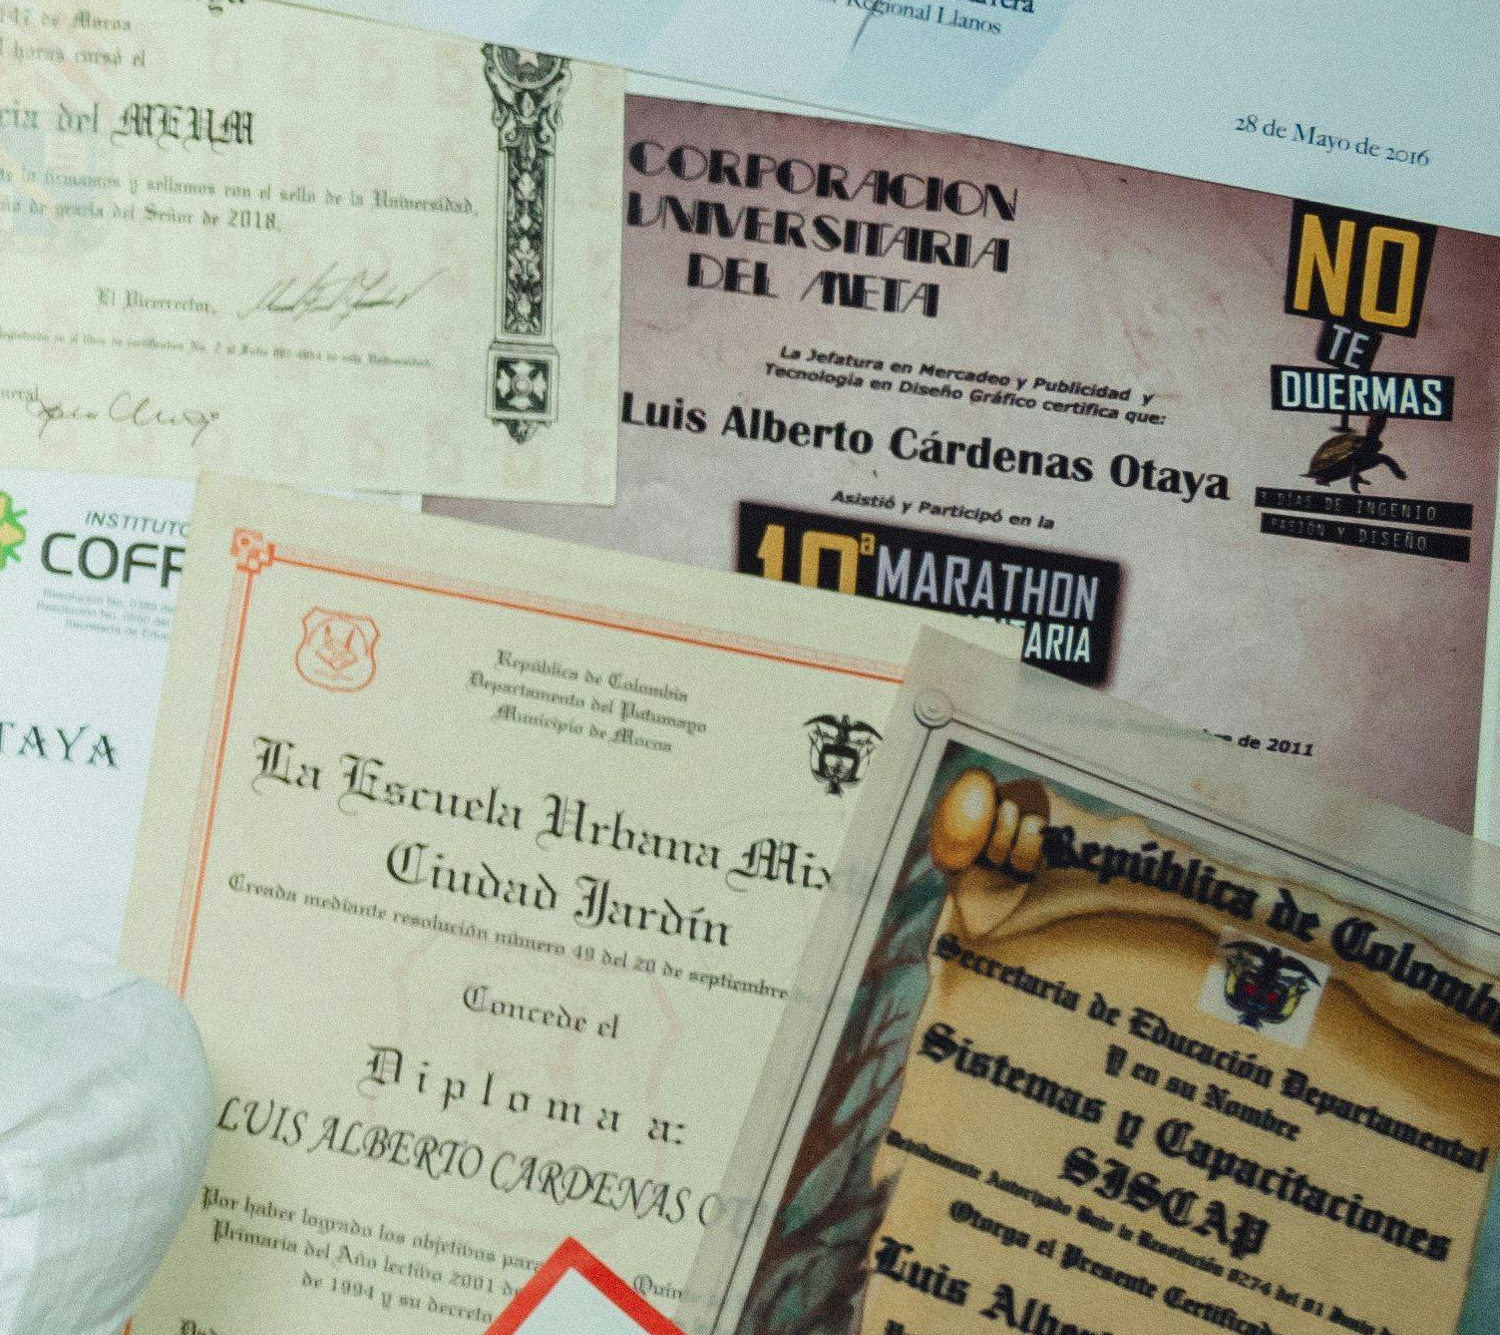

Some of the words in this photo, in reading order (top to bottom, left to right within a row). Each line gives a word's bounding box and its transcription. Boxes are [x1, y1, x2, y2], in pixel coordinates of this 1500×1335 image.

[628, 138, 1019, 221] CORPORACION
[1235, 112, 1259, 135] 28
[1263, 117, 1286, 141] de
[1289, 121, 1351, 157] Mayo
[1352, 137, 1379, 156] de
[1383, 146, 1430, 168] 2016
[626, 191, 1010, 273] UNIVERSITARIA
[1292, 212, 1421, 326] NO
[687, 252, 776, 299] DEL
[801, 269, 940, 317] META
[1327, 325, 1369, 363] TE
[1281, 372, 1443, 416] DUERMAS
[621, 392, 706, 432] Luis
[721, 405, 875, 455] Alberto
[889, 425, 1093, 483] Cárdenas
[1109, 453, 1231, 503] Otaya
[877, 544, 1098, 620] MARATHON
[250, 733, 323, 790] La
[340, 753, 523, 832] Escuela
[542, 792, 720, 871] Urbana
[1040, 826, 1259, 923] República
[1270, 888, 1322, 938] de
[917, 1022, 1104, 1125] Sistemas
[1118, 1111, 1144, 1149] y
[1153, 1114, 1453, 1263] Capacitaciones
[1060, 1144, 1270, 1261] SISCAP
[873, 1233, 968, 1301] Luis
